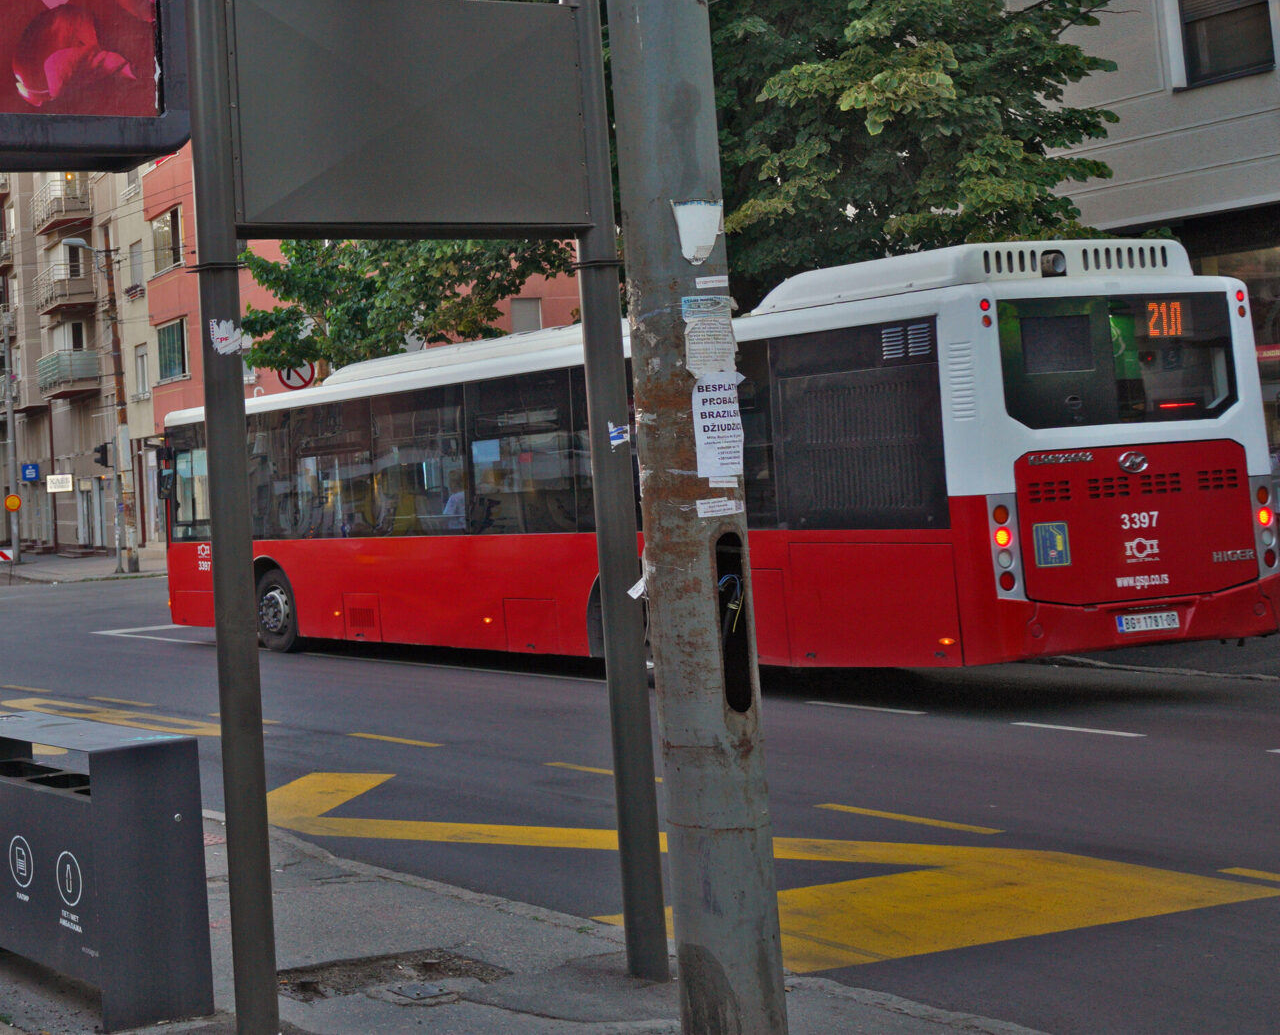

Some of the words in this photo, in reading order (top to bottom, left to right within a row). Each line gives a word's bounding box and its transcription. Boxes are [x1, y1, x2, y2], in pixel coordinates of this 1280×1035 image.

[1121, 511, 1159, 529] 3397
[1212, 549, 1255, 563] HIGER
[1116, 574, 1169, 590] www.gsp.co.rs
